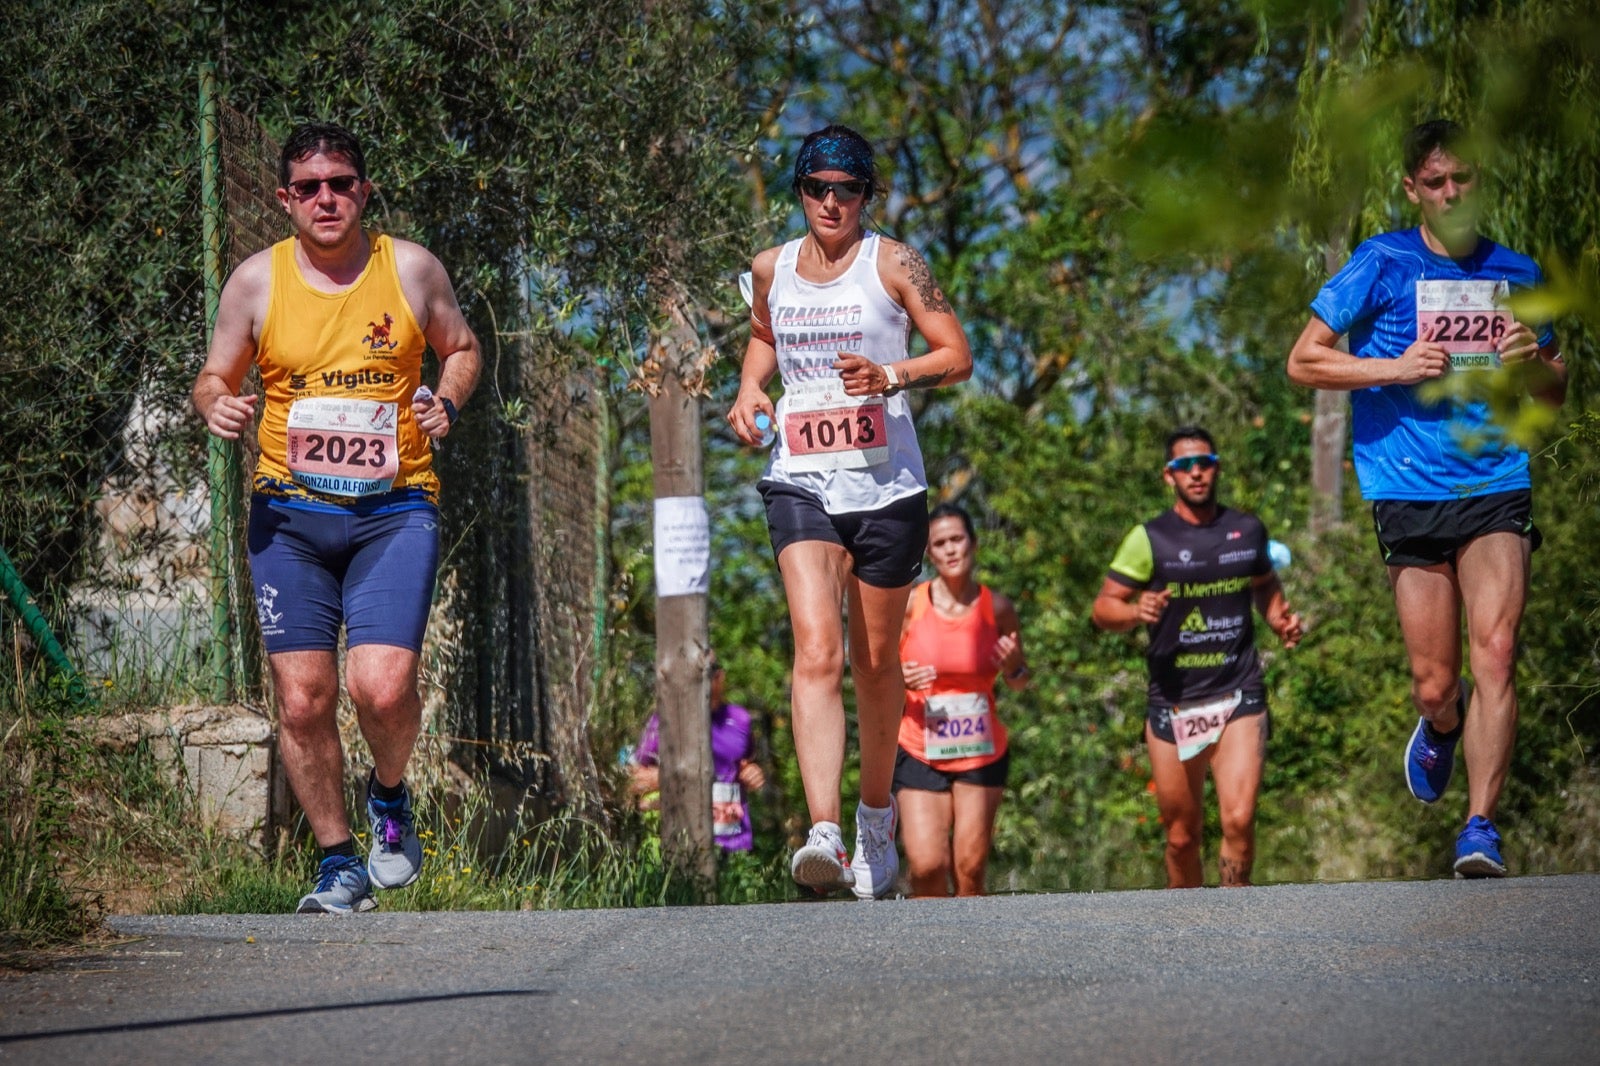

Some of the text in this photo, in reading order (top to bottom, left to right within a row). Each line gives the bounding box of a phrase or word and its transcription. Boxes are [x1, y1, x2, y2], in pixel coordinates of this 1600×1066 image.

[775, 304, 863, 326] TRAINING
[1434, 315, 1505, 342] 2226
[778, 331, 863, 352] TRAINING
[1450, 355, 1490, 368] RANCISCO
[321, 368, 395, 390] Vigilsa
[799, 416, 876, 449] 1013
[304, 434, 387, 468] 2023
[342, 480, 381, 493] ALFONSO
[937, 716, 985, 738] 2024
